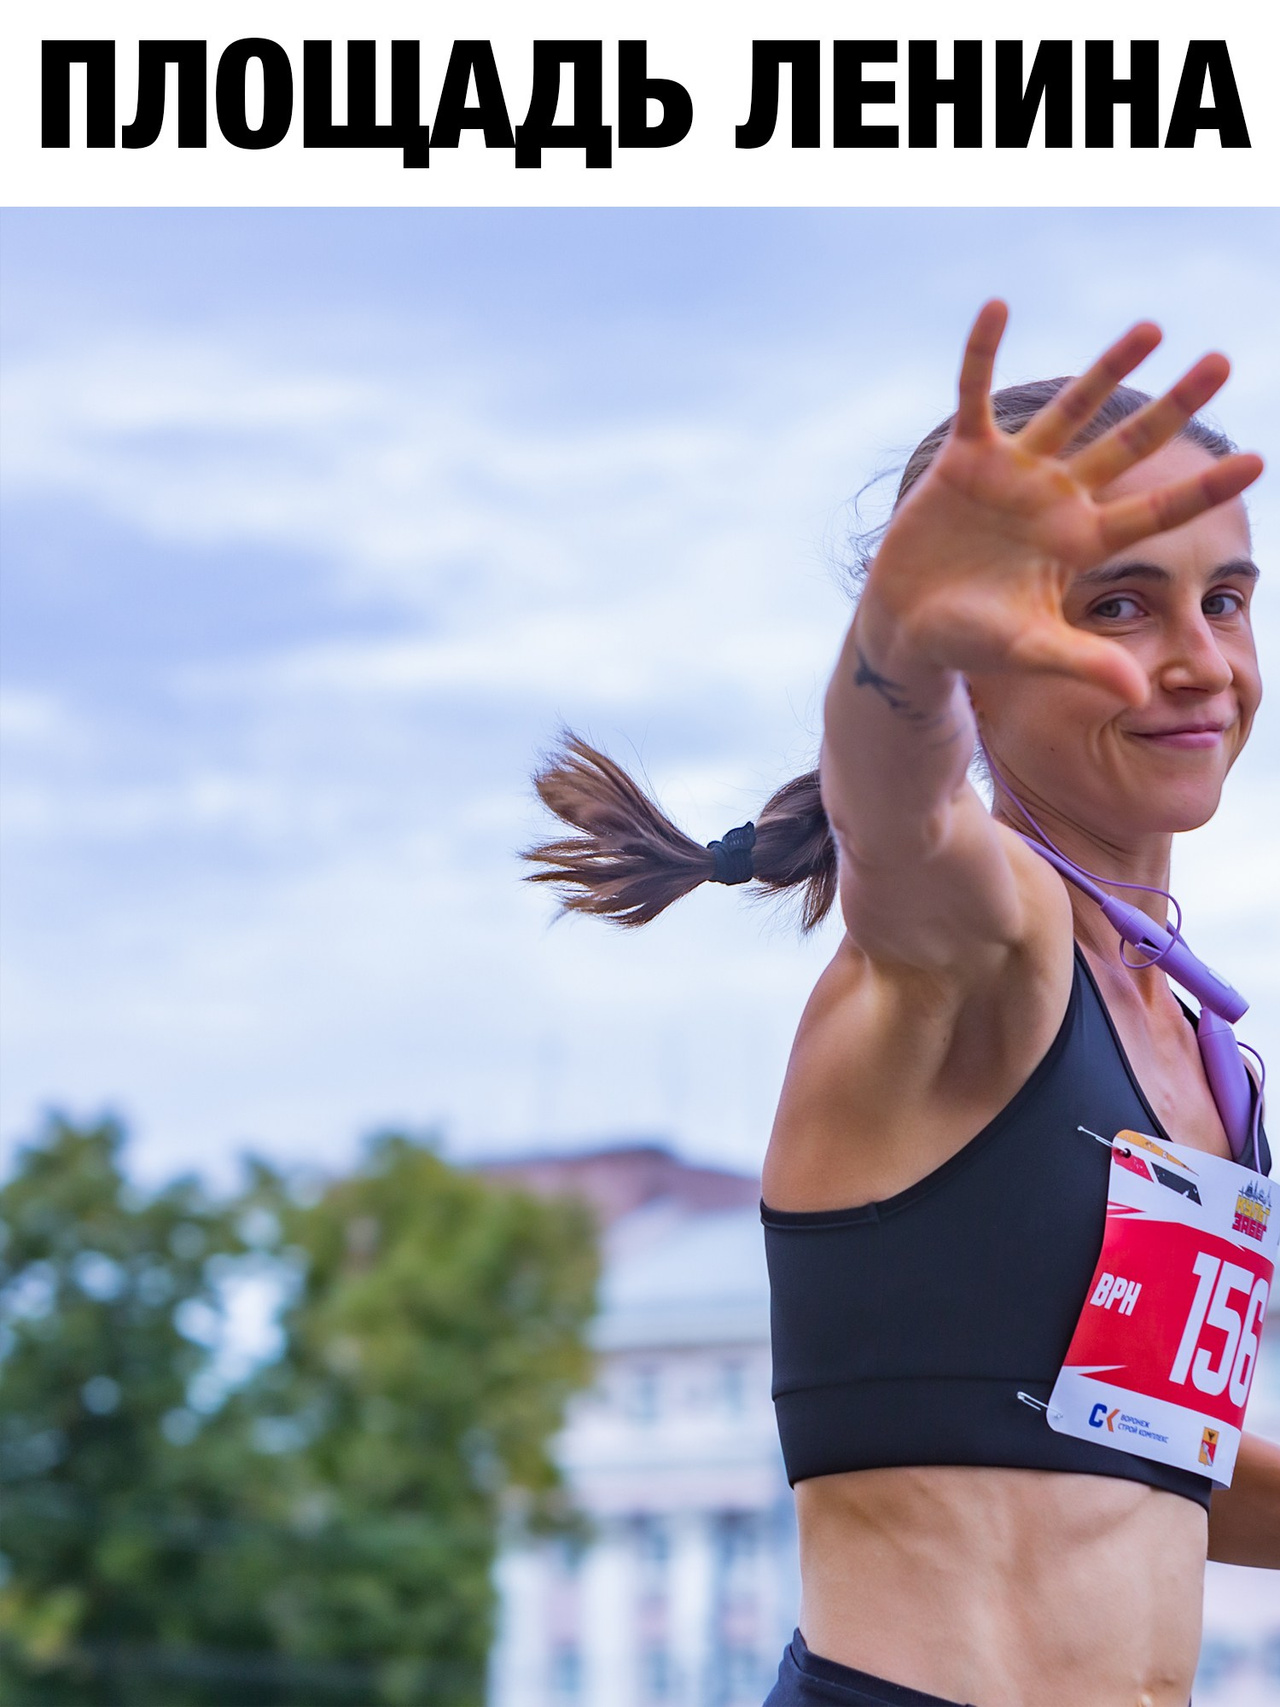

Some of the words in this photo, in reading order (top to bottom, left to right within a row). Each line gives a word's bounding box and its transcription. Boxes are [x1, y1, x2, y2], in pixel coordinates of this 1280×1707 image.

[1232, 1211, 1267, 1242] ЗАБЕГ
[1090, 1273, 1143, 1317] ВРН
[1168, 1251, 1270, 1408] 156
[1117, 1423, 1138, 1435] СТРОЙ
[1138, 1429, 1169, 1444] КОМПЛЕКС
[1120, 1414, 1150, 1428] ВОРОНЕЖ
